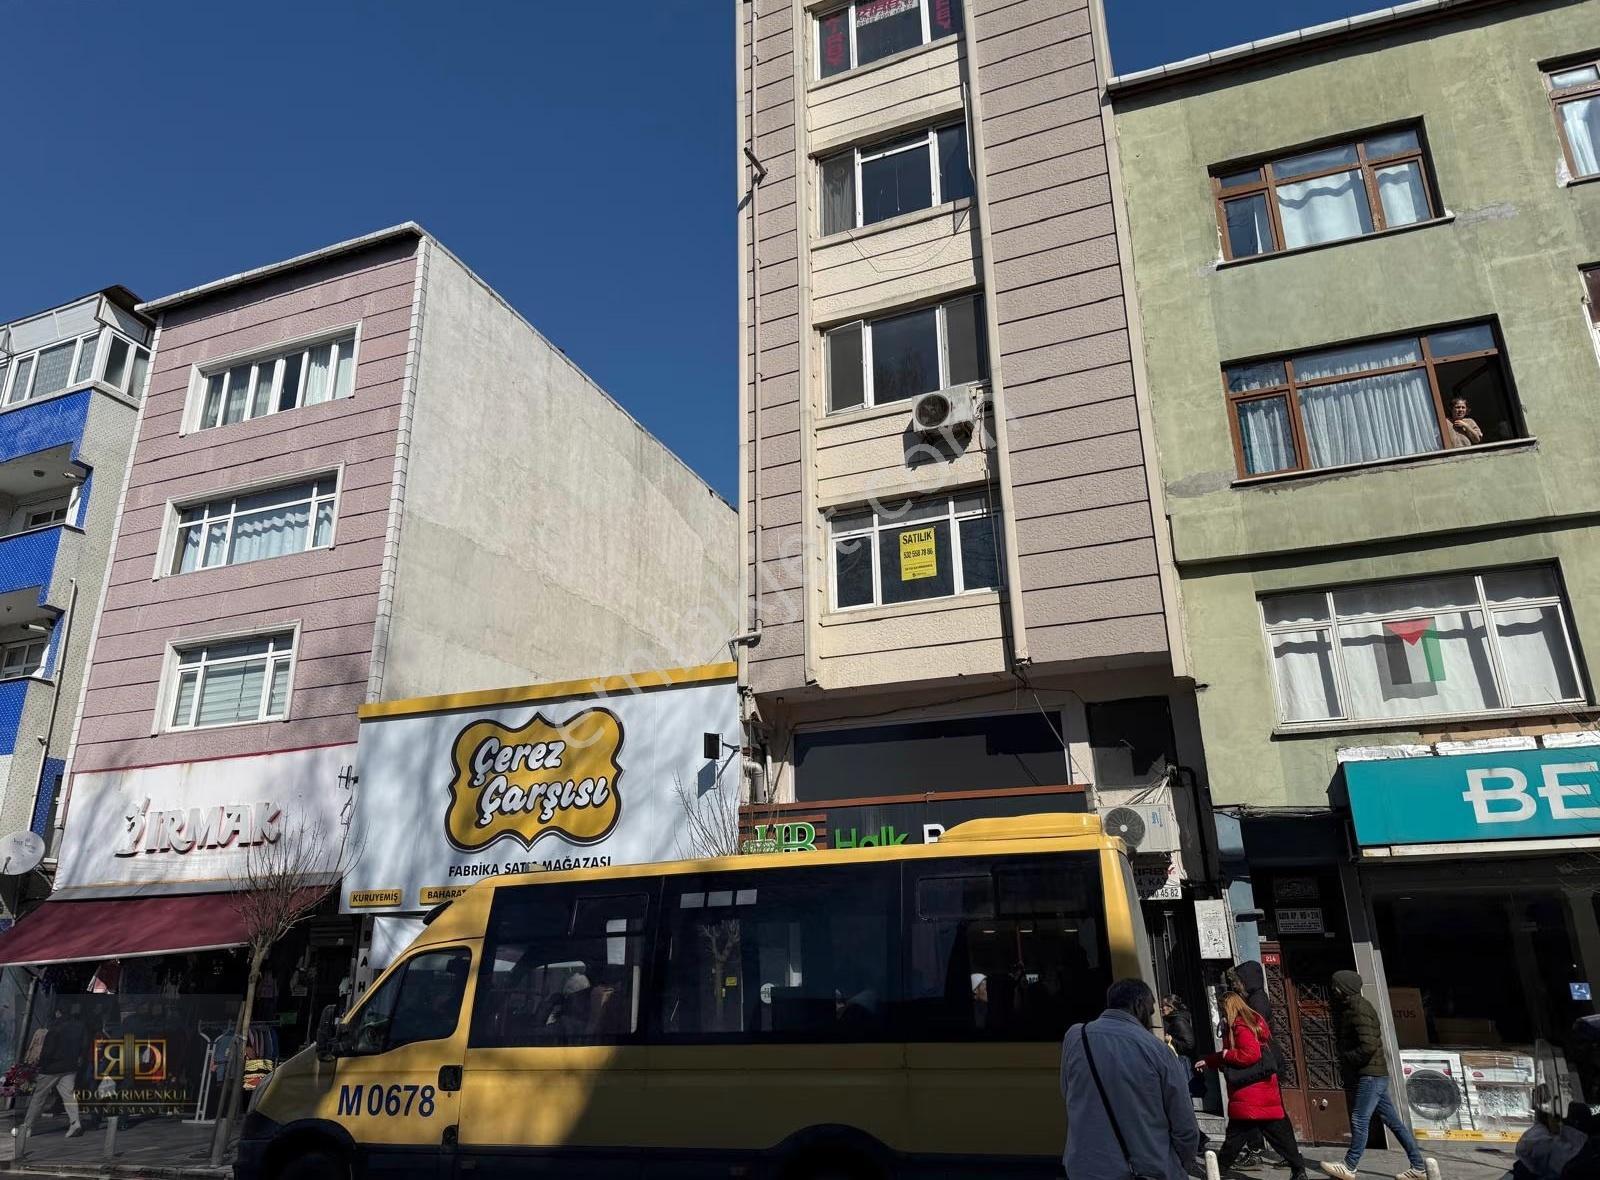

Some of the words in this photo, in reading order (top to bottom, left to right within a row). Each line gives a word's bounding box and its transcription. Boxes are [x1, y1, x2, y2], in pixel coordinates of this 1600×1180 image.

[903, 531, 932, 544] SATILIK
[470, 737, 566, 787] Çerez
[478, 775, 610, 827] Çarşısı
[448, 862, 499, 877] FABRİKA
[352, 892, 398, 903] KURUYEMİŞ
[1161, 889, 1169, 897] 45
[1170, 888, 1179, 897] 82
